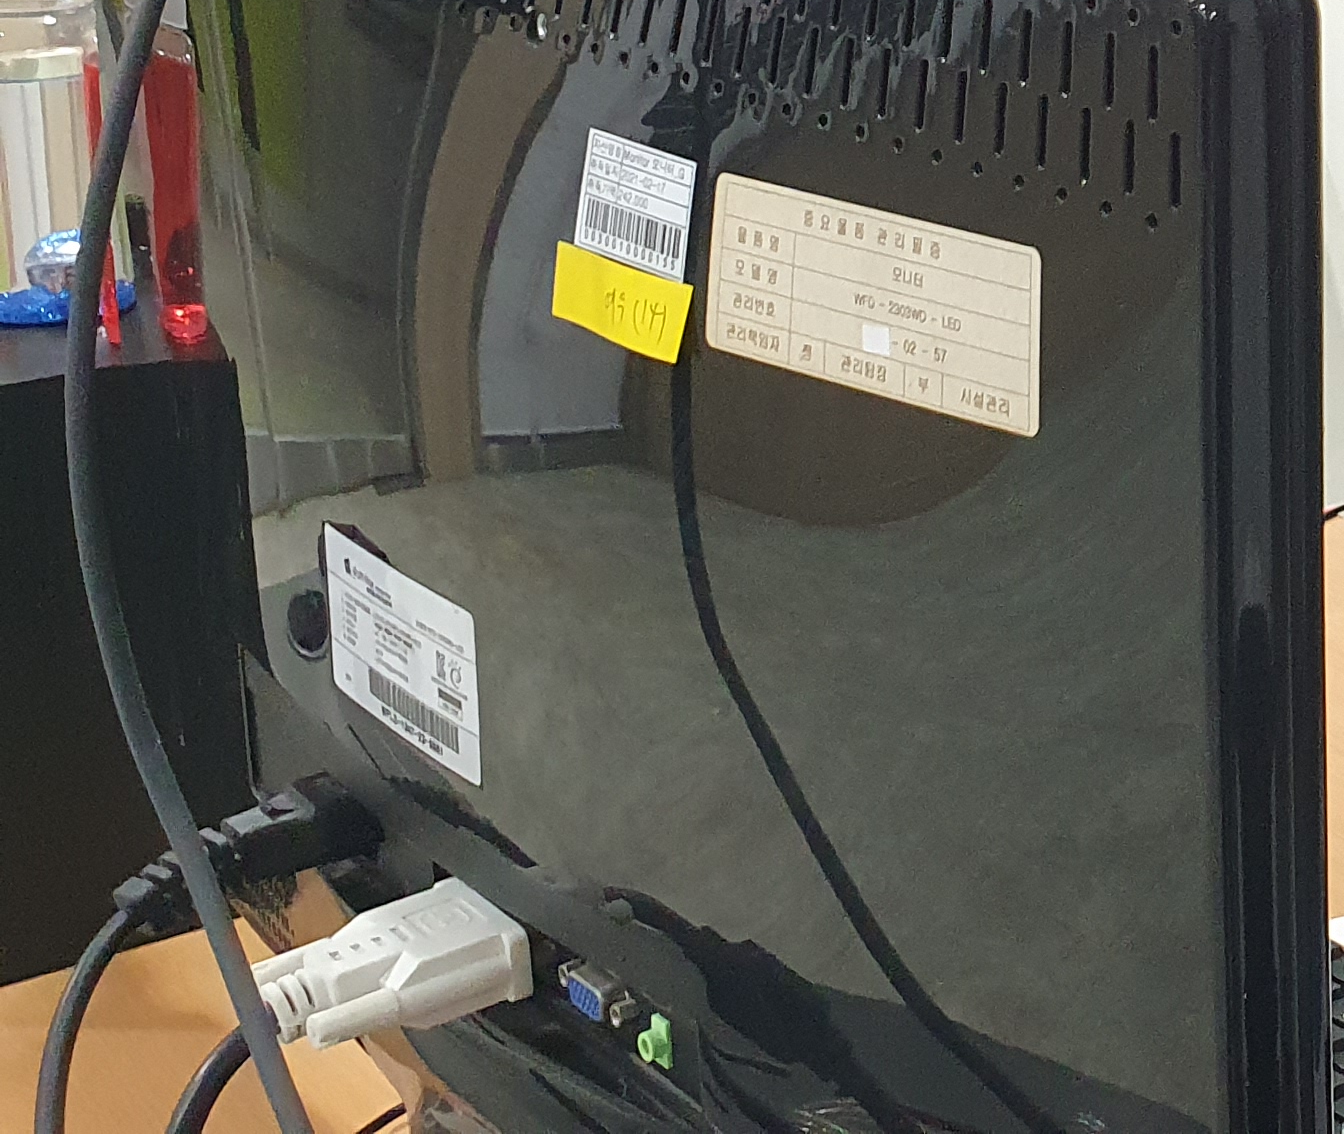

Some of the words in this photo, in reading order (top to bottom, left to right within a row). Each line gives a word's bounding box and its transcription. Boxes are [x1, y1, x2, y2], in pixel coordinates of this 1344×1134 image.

[892, 266, 924, 289] 모니터
[732, 292, 776, 317] 관리번호
[941, 316, 961, 332] LED
[726, 322, 780, 352] 관리책임자
